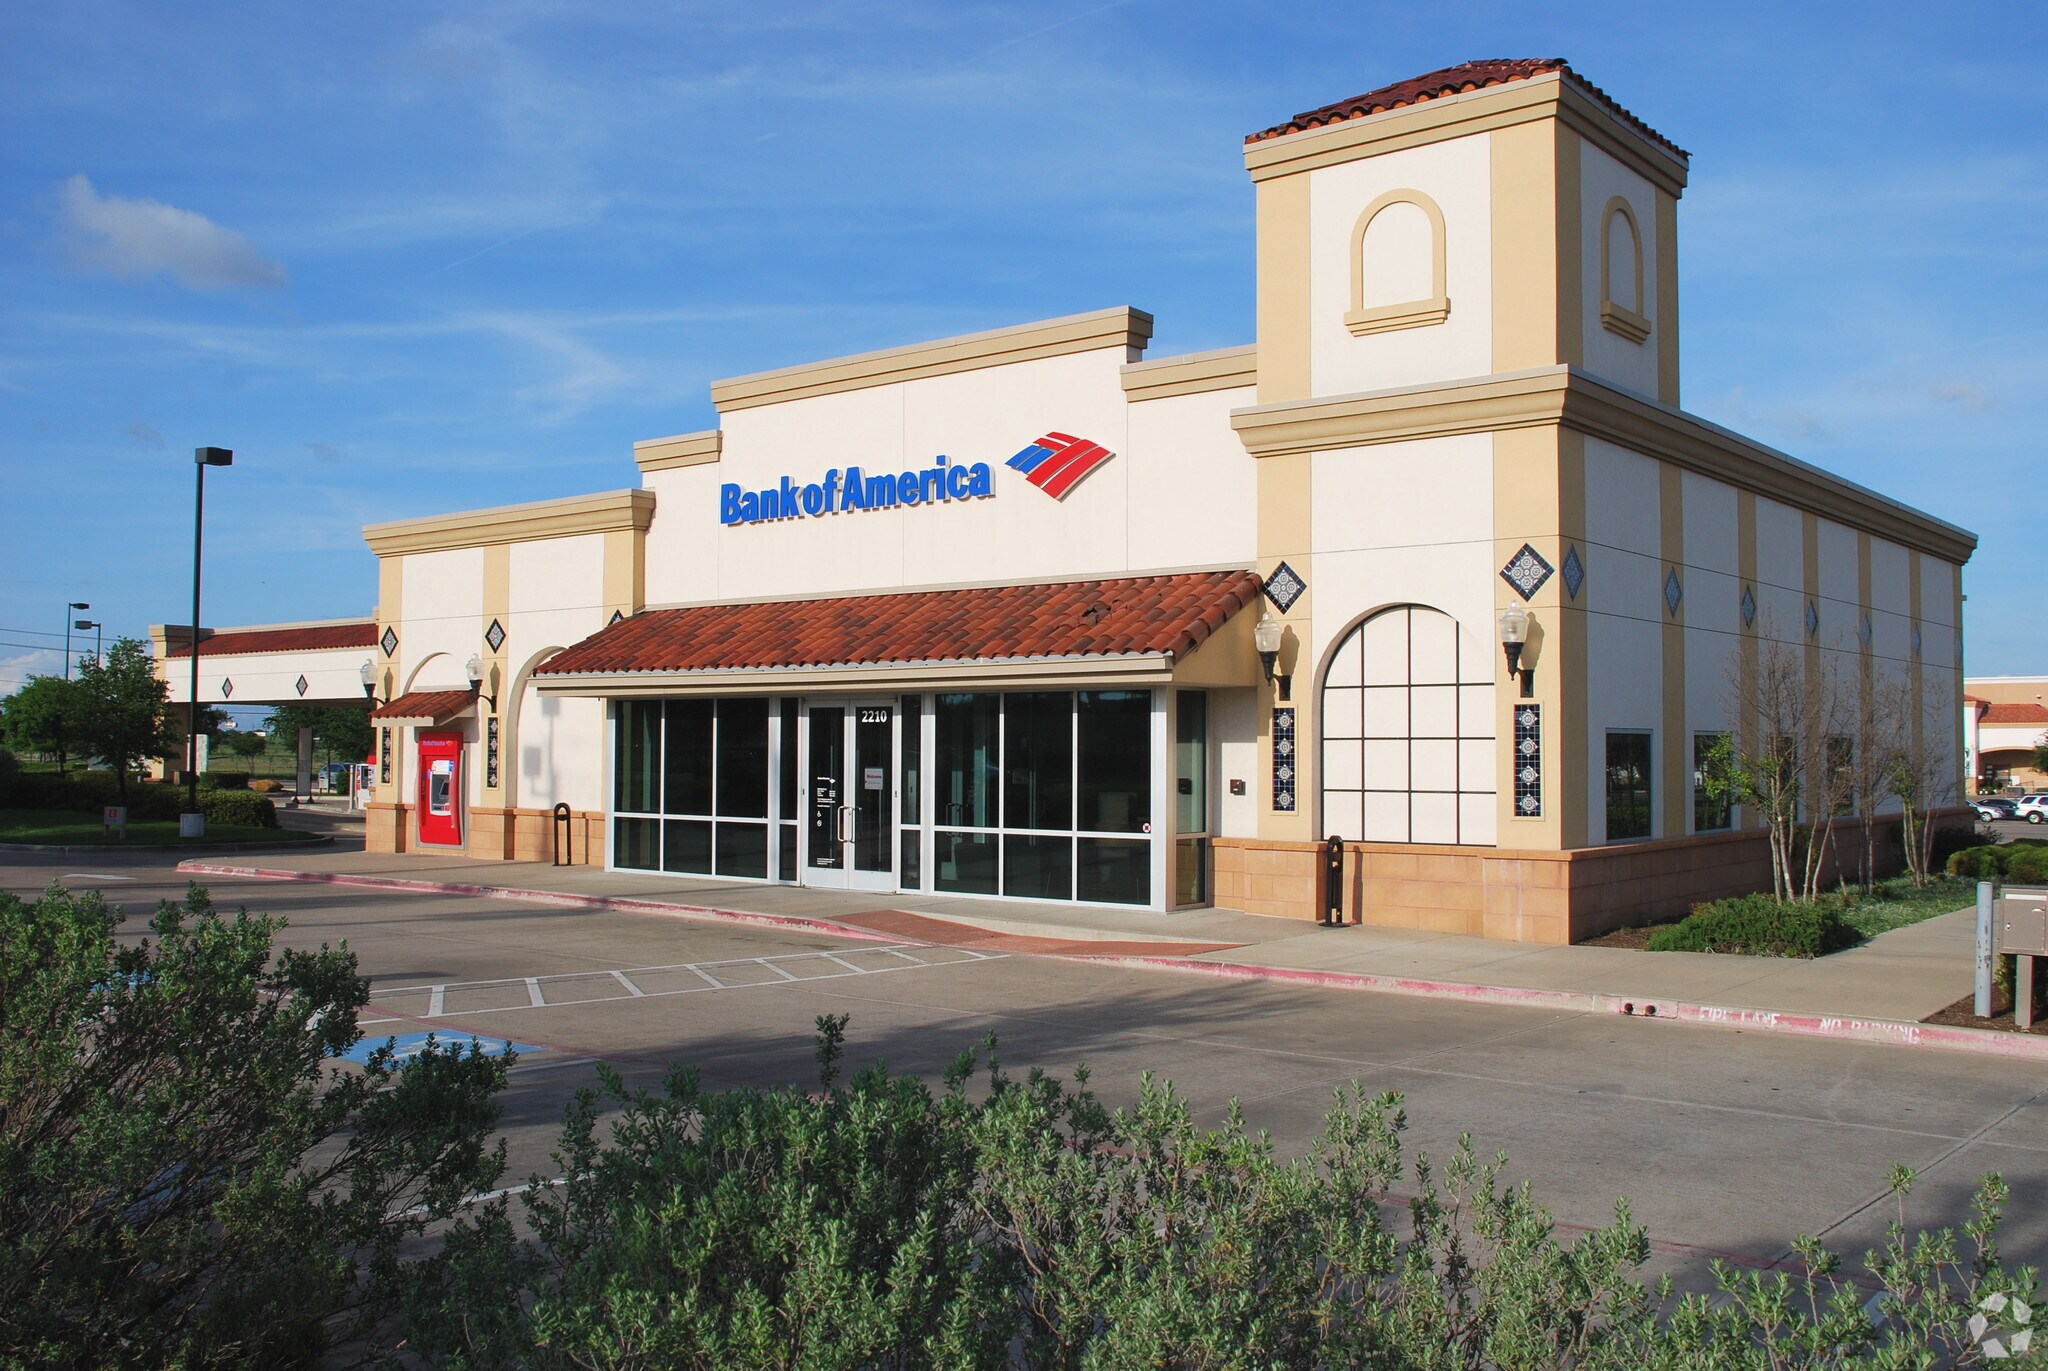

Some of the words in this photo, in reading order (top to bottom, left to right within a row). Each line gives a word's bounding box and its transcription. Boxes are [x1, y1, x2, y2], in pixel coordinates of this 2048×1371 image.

[721, 475, 802, 525] Bank
[802, 468, 840, 516] of
[840, 454, 993, 511] America
[861, 710, 887, 723] 2210
[1820, 1018, 1842, 1030] NO
